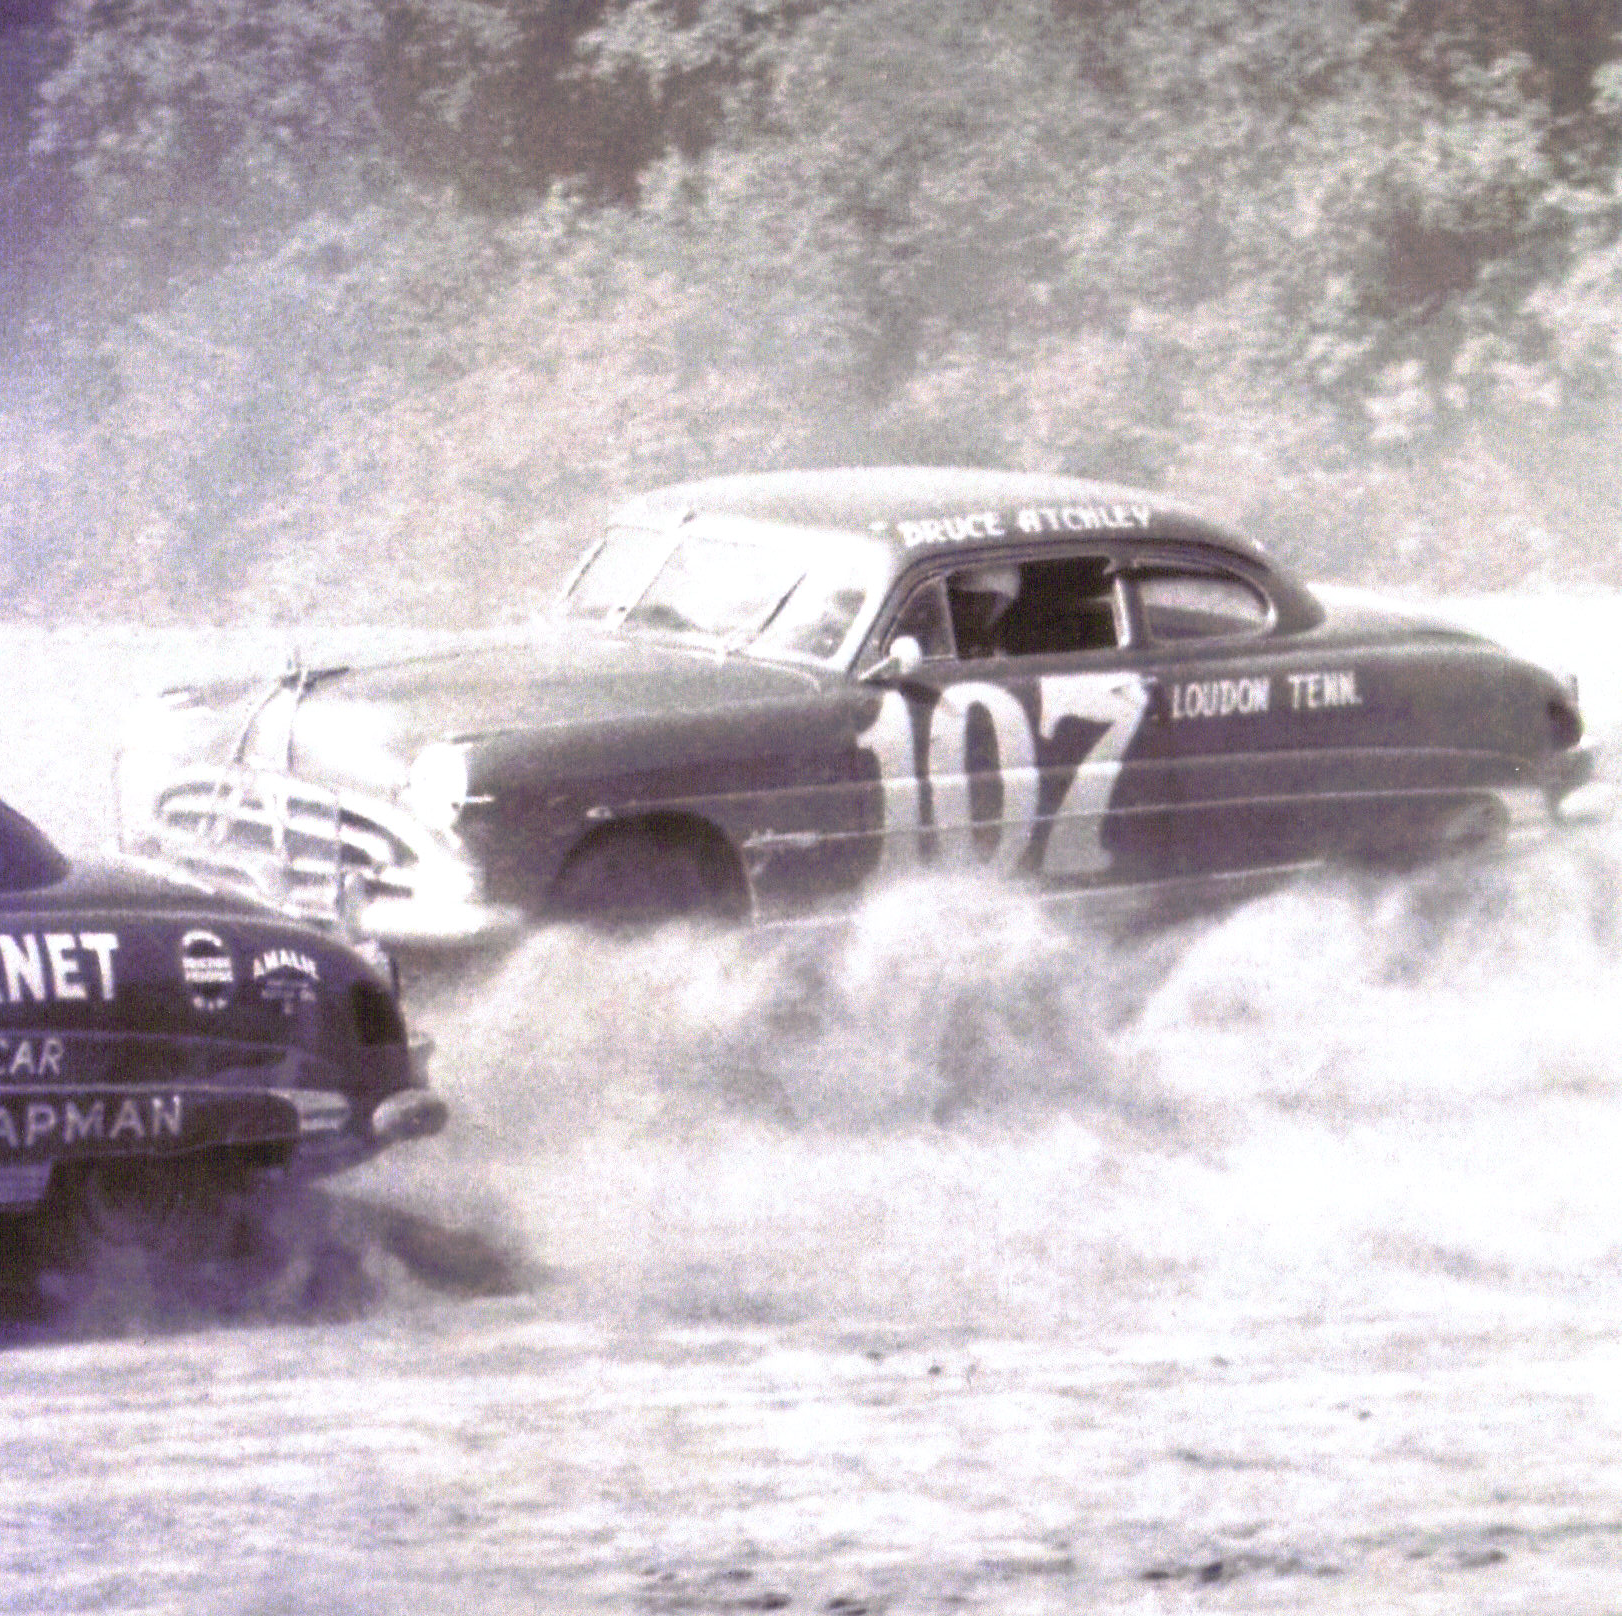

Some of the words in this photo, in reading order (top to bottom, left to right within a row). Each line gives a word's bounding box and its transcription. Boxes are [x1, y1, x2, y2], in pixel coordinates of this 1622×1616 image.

[897, 512, 1005, 548] BRUCE
[1017, 505, 1150, 534] ATCHLEY
[1172, 676, 1270, 720] LOUDON
[856, 672, 1148, 880] 107
